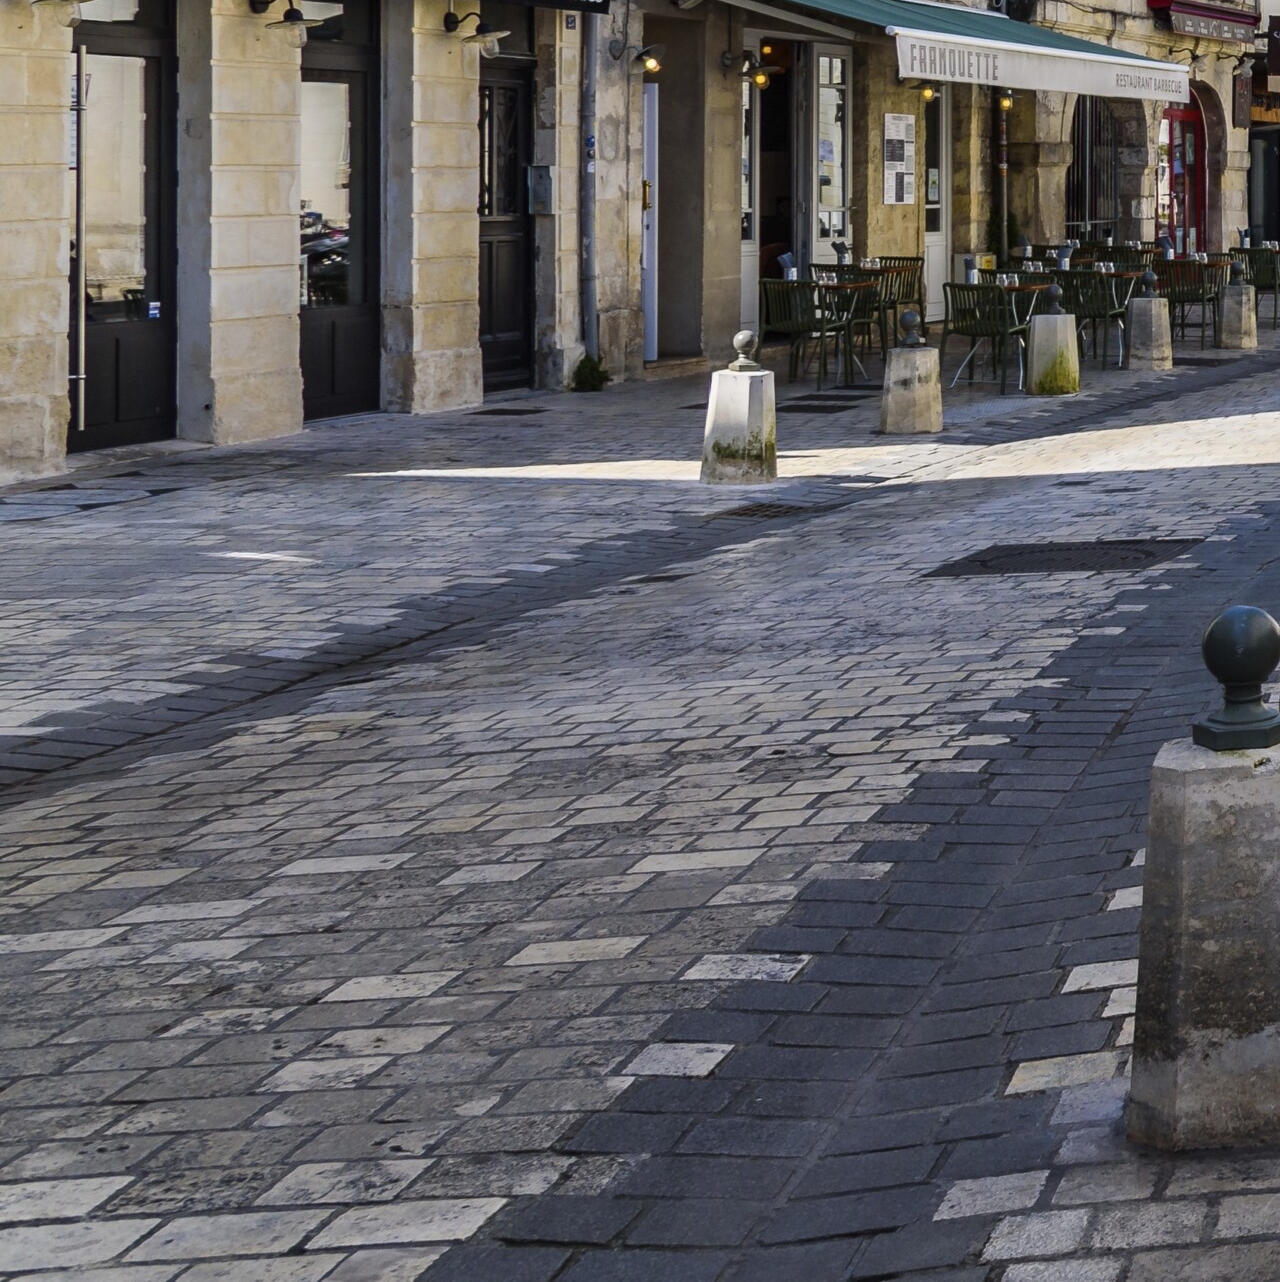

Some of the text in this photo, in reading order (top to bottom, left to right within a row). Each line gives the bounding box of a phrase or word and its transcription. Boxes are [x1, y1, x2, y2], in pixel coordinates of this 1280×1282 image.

[910, 43, 999, 81] FRANQUETTE
[1115, 72, 1182, 94] RESTAURANT BARBECUE
